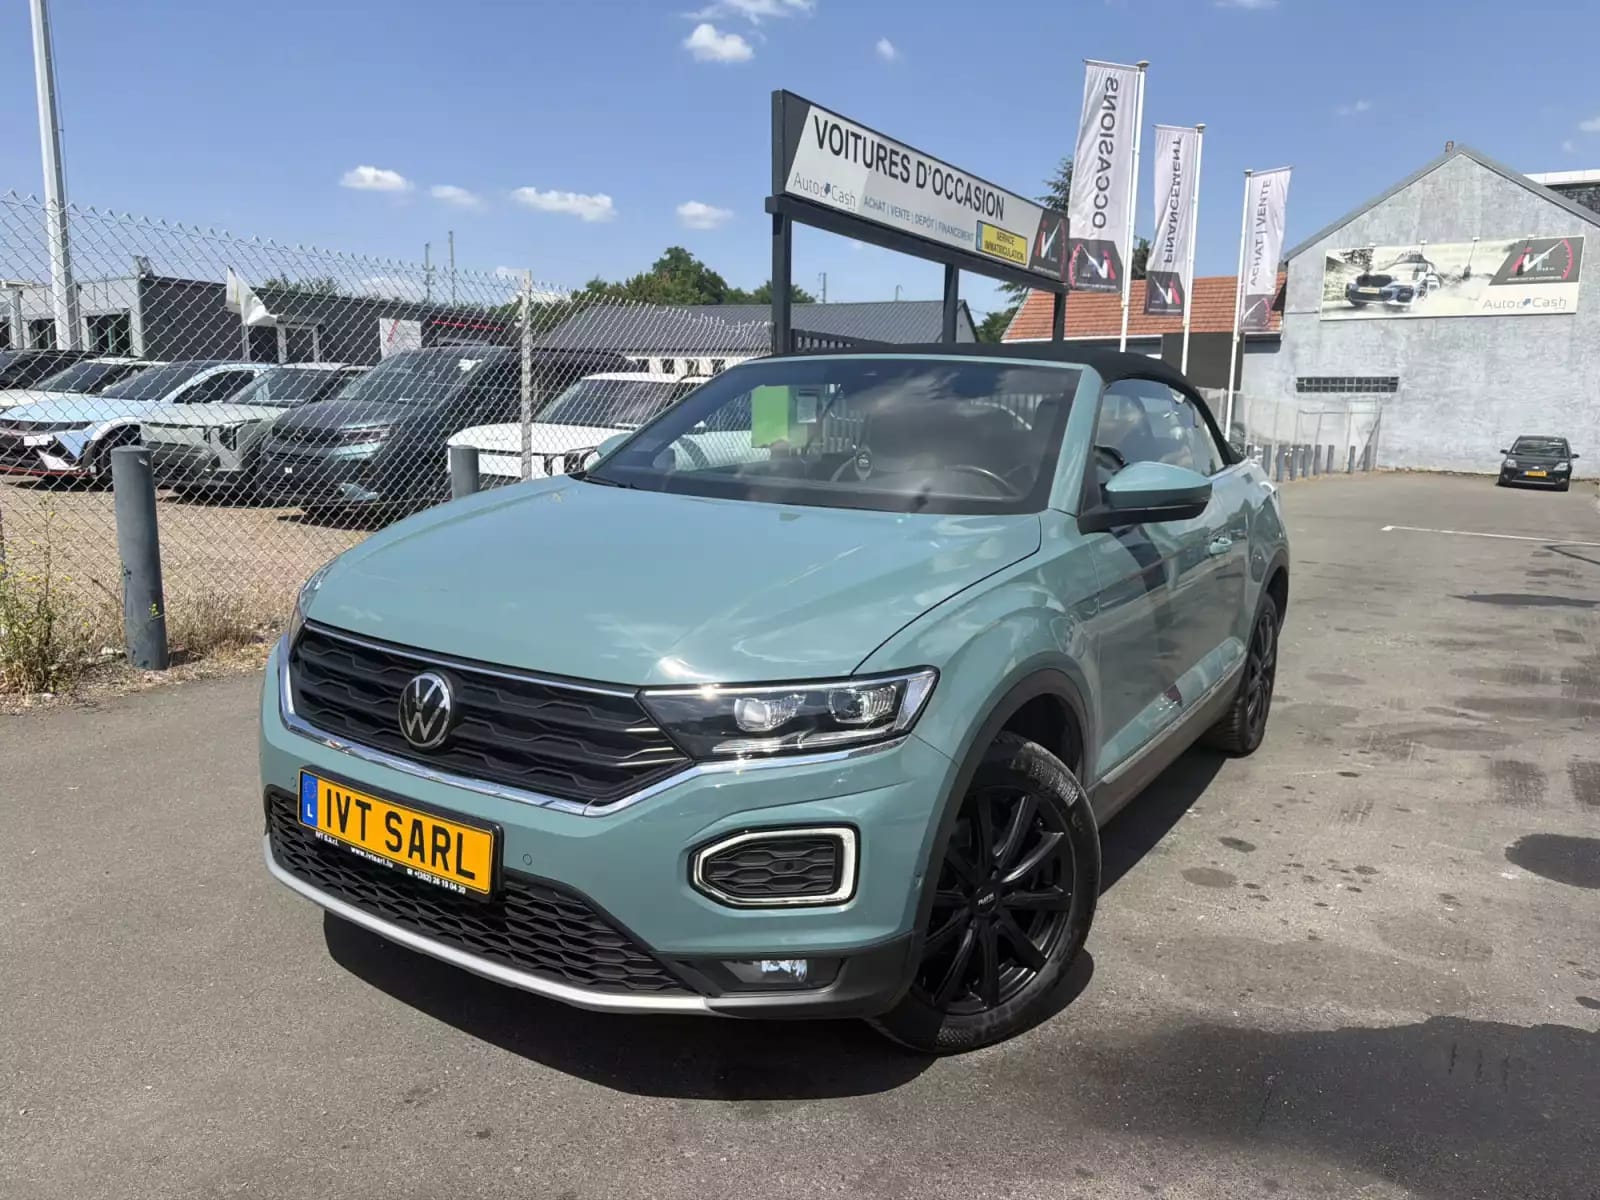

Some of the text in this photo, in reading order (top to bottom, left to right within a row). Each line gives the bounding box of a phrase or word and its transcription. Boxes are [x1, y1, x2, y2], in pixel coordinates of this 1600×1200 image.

[814, 114, 1004, 221] VOITURES D'OCCASION
[831, 184, 856, 211] Cash
[864, 195, 886, 213] ACHAT
[891, 204, 910, 221] VENTE
[1251, 179, 1272, 287] ACHAT VENTE
[1532, 297, 1567, 309] Cash
[306, 803, 314, 818] L
[326, 788, 476, 881] IVT SARL
